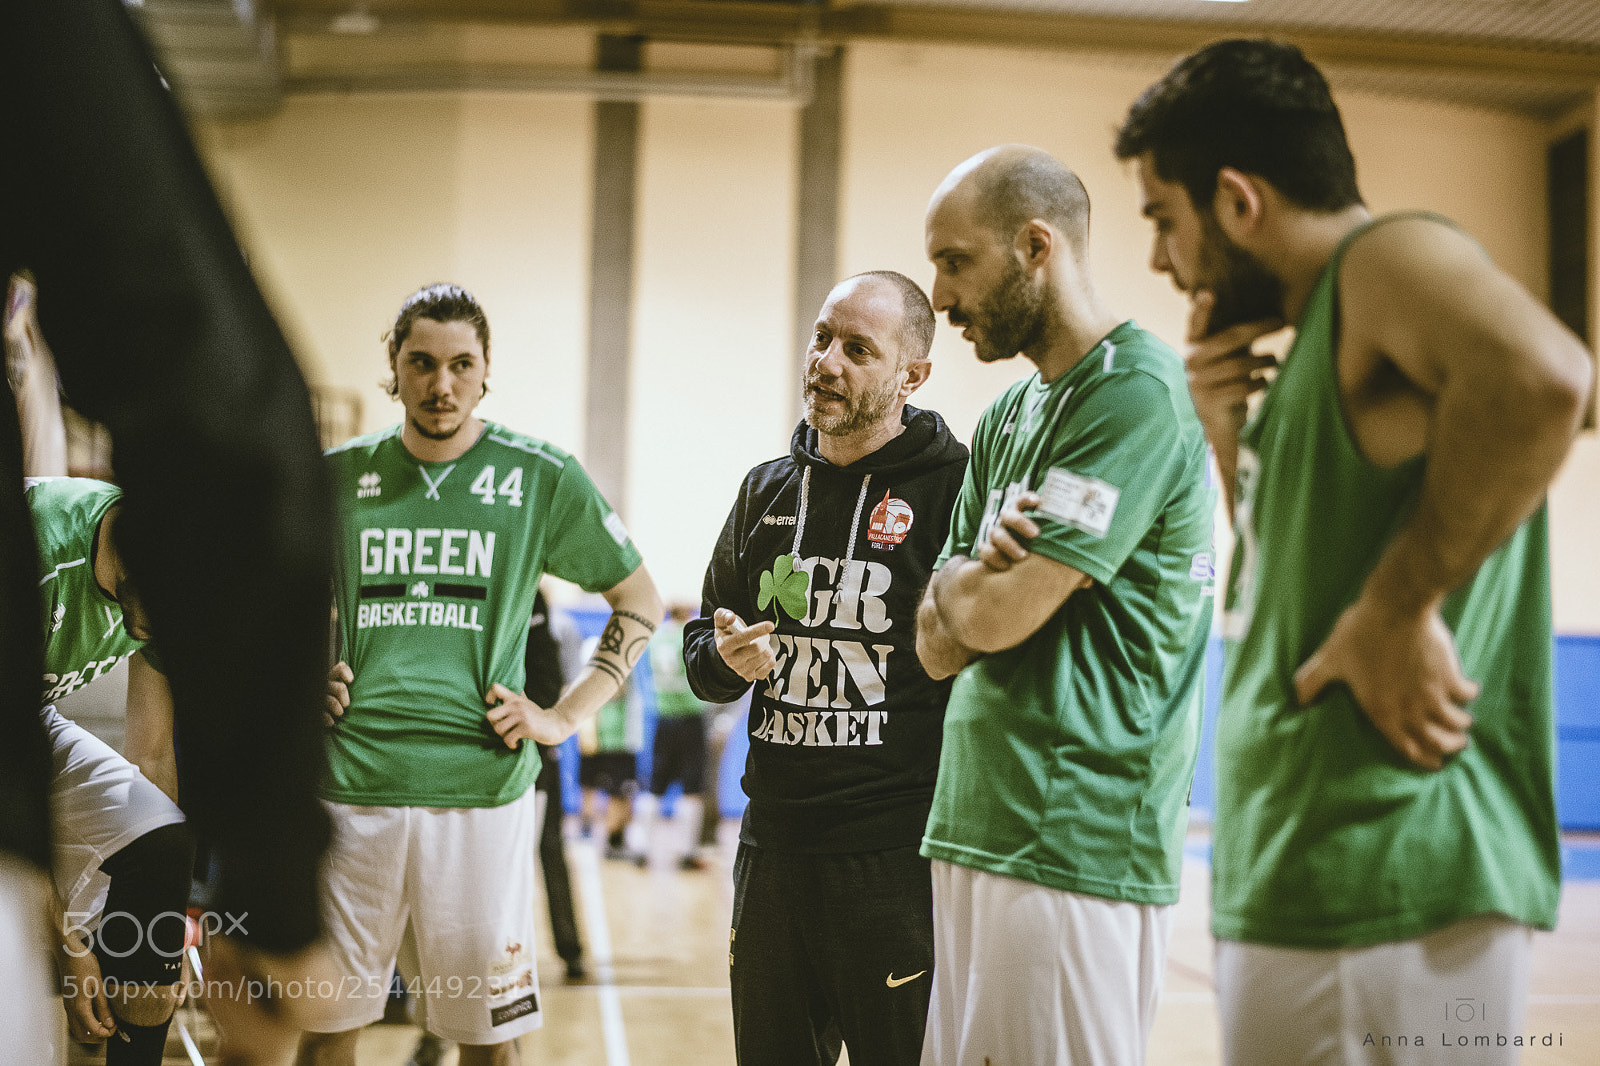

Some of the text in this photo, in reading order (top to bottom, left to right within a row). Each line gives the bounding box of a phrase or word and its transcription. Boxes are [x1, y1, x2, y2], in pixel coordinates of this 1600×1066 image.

[471, 465, 524, 508] 44
[360, 527, 496, 578] GREEN
[357, 602, 483, 632] BASKETBALL
[799, 556, 893, 634] GR
